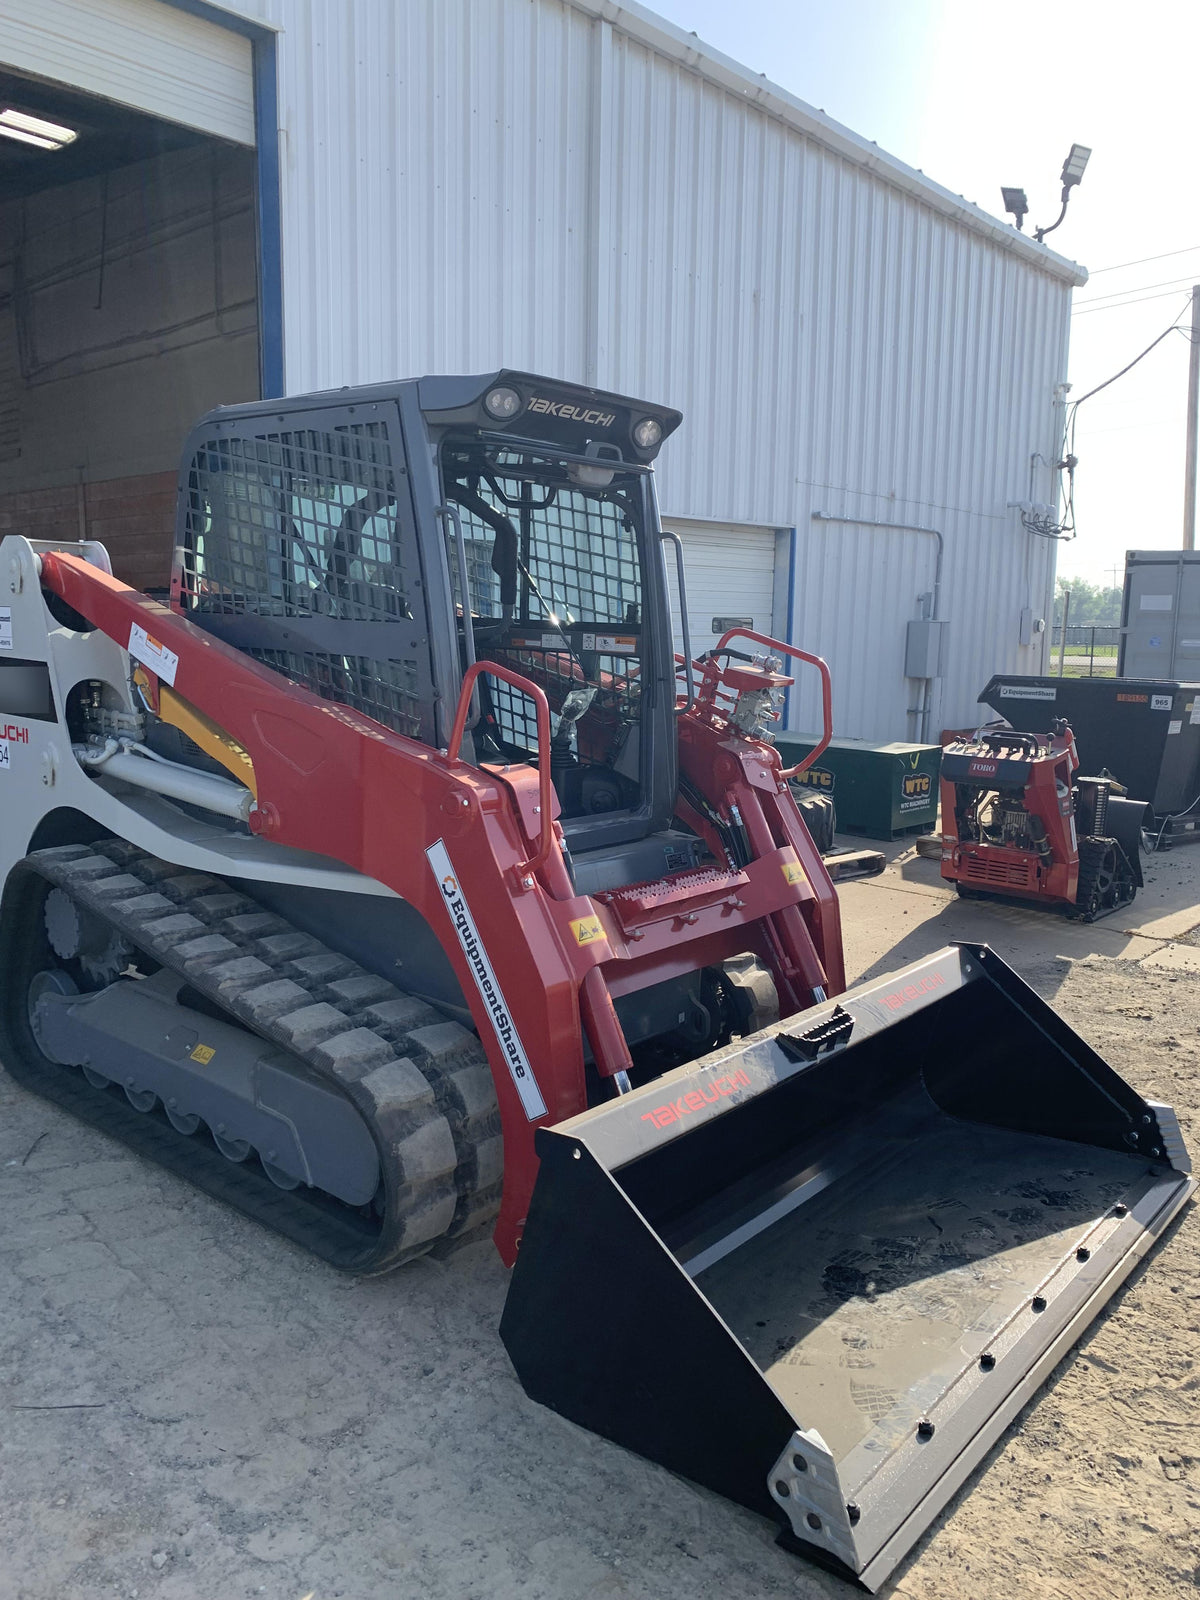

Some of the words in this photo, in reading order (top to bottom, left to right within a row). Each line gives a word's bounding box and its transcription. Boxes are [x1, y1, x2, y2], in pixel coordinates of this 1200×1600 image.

[527, 397, 616, 428] TAKEUCHI
[1008, 689, 1055, 697] EquipmentShare
[796, 770, 832, 786] WTC
[971, 763, 996, 772] TORO
[905, 777, 930, 794] WTC
[450, 897, 527, 1079] EquipmentShare
[878, 973, 946, 1012] TAKEUCHI
[640, 1068, 752, 1131] TAKEUCHI
